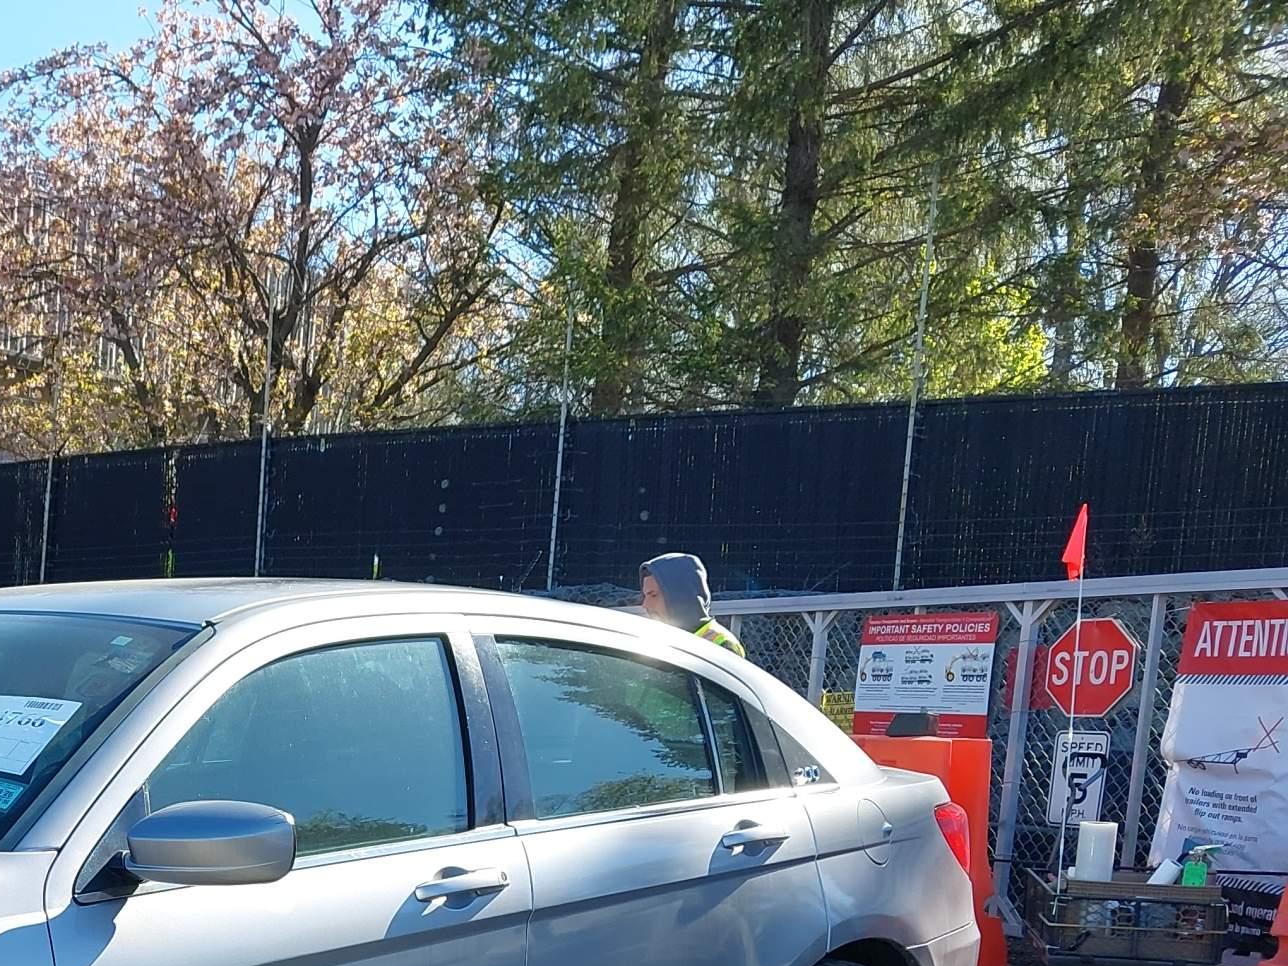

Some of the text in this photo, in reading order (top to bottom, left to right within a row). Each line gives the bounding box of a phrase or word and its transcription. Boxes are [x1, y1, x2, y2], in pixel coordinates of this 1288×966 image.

[868, 622, 991, 635] IMPORTANT SAFETY POLICIES
[1193, 618, 1288, 658] ATTENTI
[1052, 649, 1129, 686] STOP
[825, 694, 855, 704] WARNIN
[1061, 741, 1104, 753] SPEED
[1066, 772, 1088, 805] 5
[1188, 787, 1200, 796] No
[1201, 789, 1224, 801] loading
[1061, 808, 1085, 819] PH
[1194, 808, 1207, 818] flip
[1207, 812, 1221, 820] out
[1212, 802, 1227, 810] with
[1228, 804, 1257, 814] extended
[1245, 906, 1277, 921] operat
